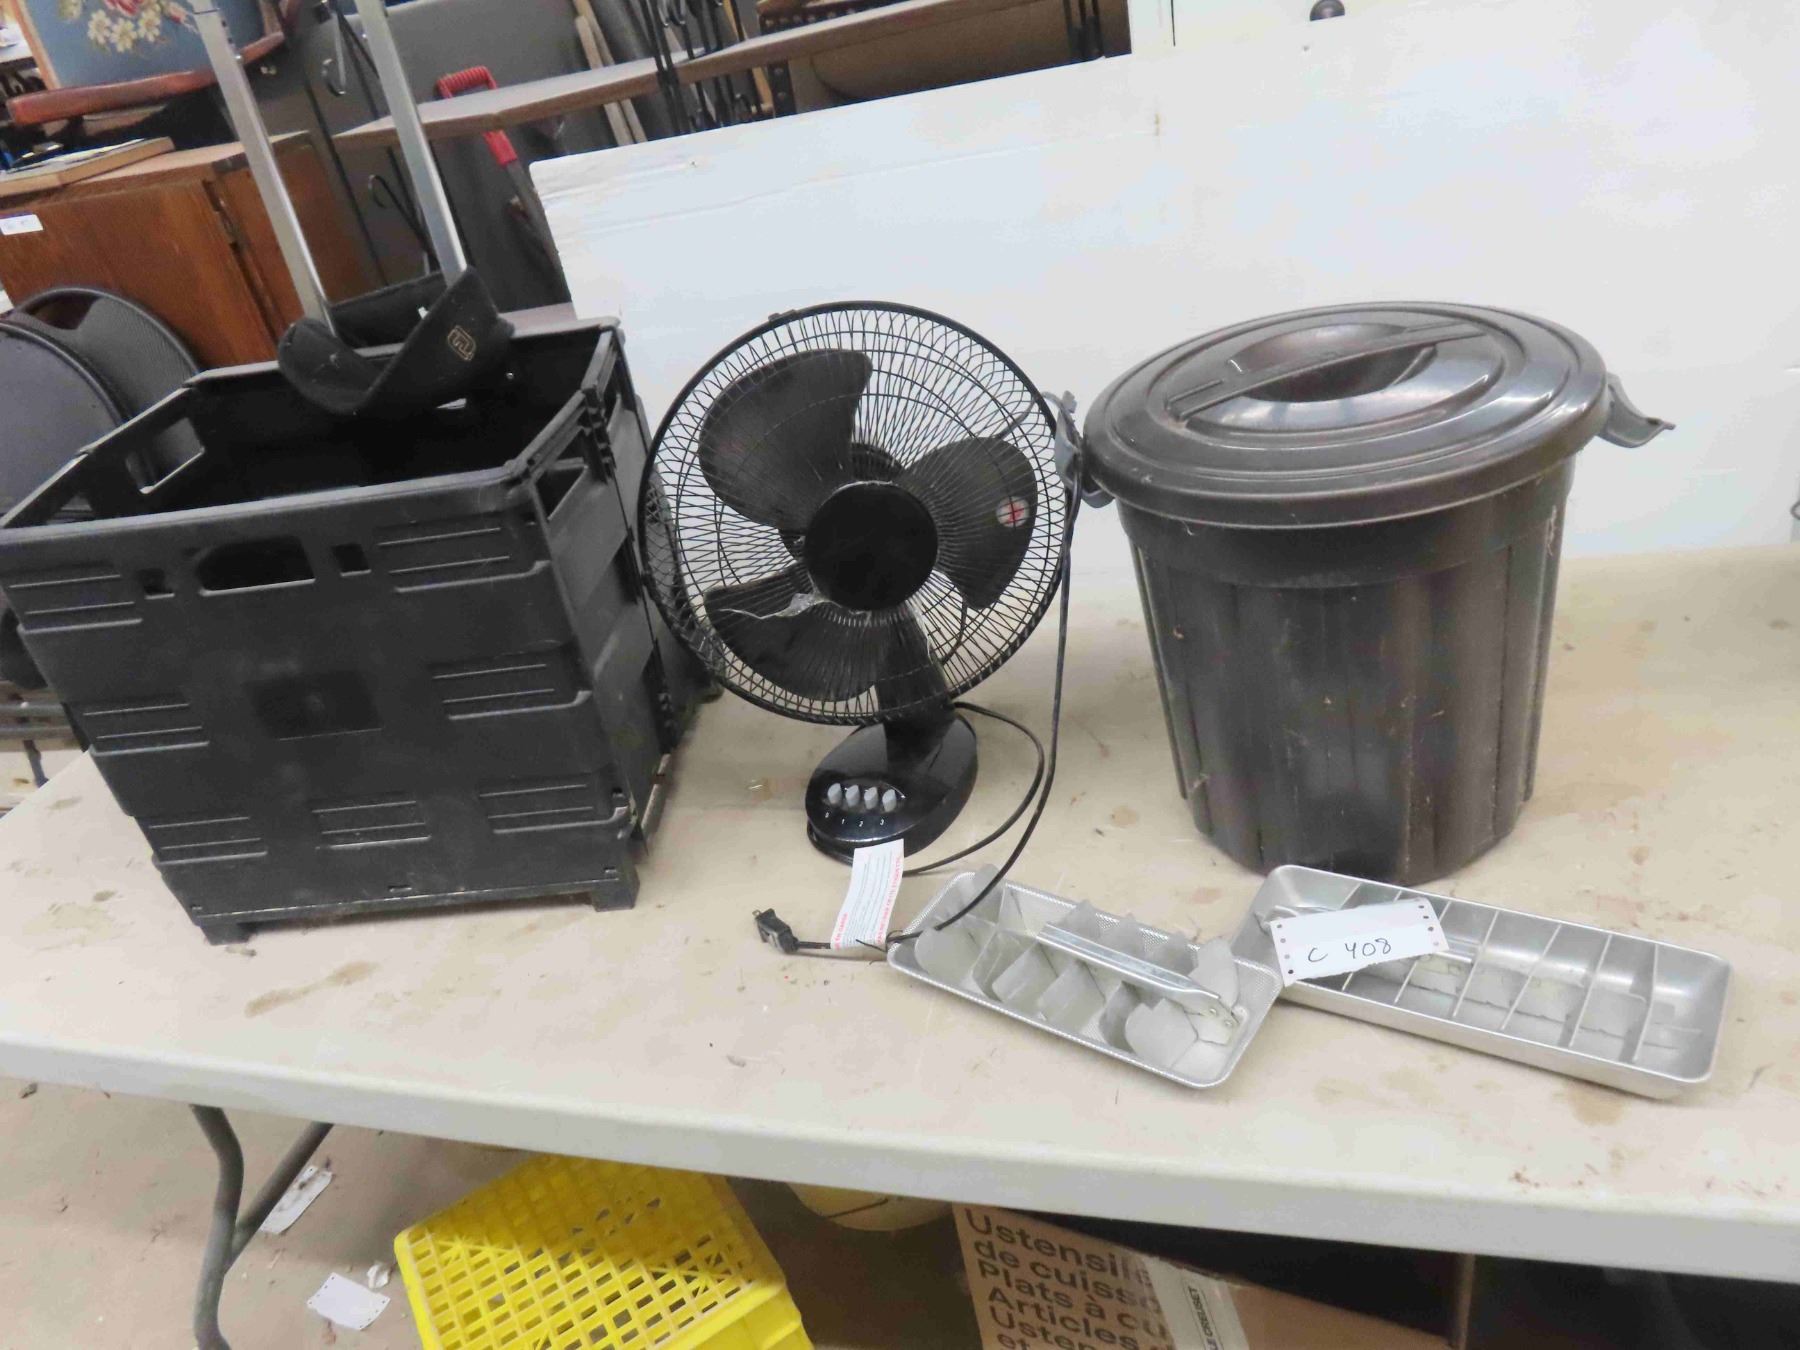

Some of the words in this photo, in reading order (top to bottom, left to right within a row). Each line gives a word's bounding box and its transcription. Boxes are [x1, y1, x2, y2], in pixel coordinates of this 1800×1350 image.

[1307, 947, 1328, 963] C
[1344, 937, 1392, 959] 408
[974, 1241, 1020, 1269] de
[978, 1258, 1073, 1309] Plats
[1085, 1293, 1107, 1321] à
[988, 1286, 1140, 1350] Articles
